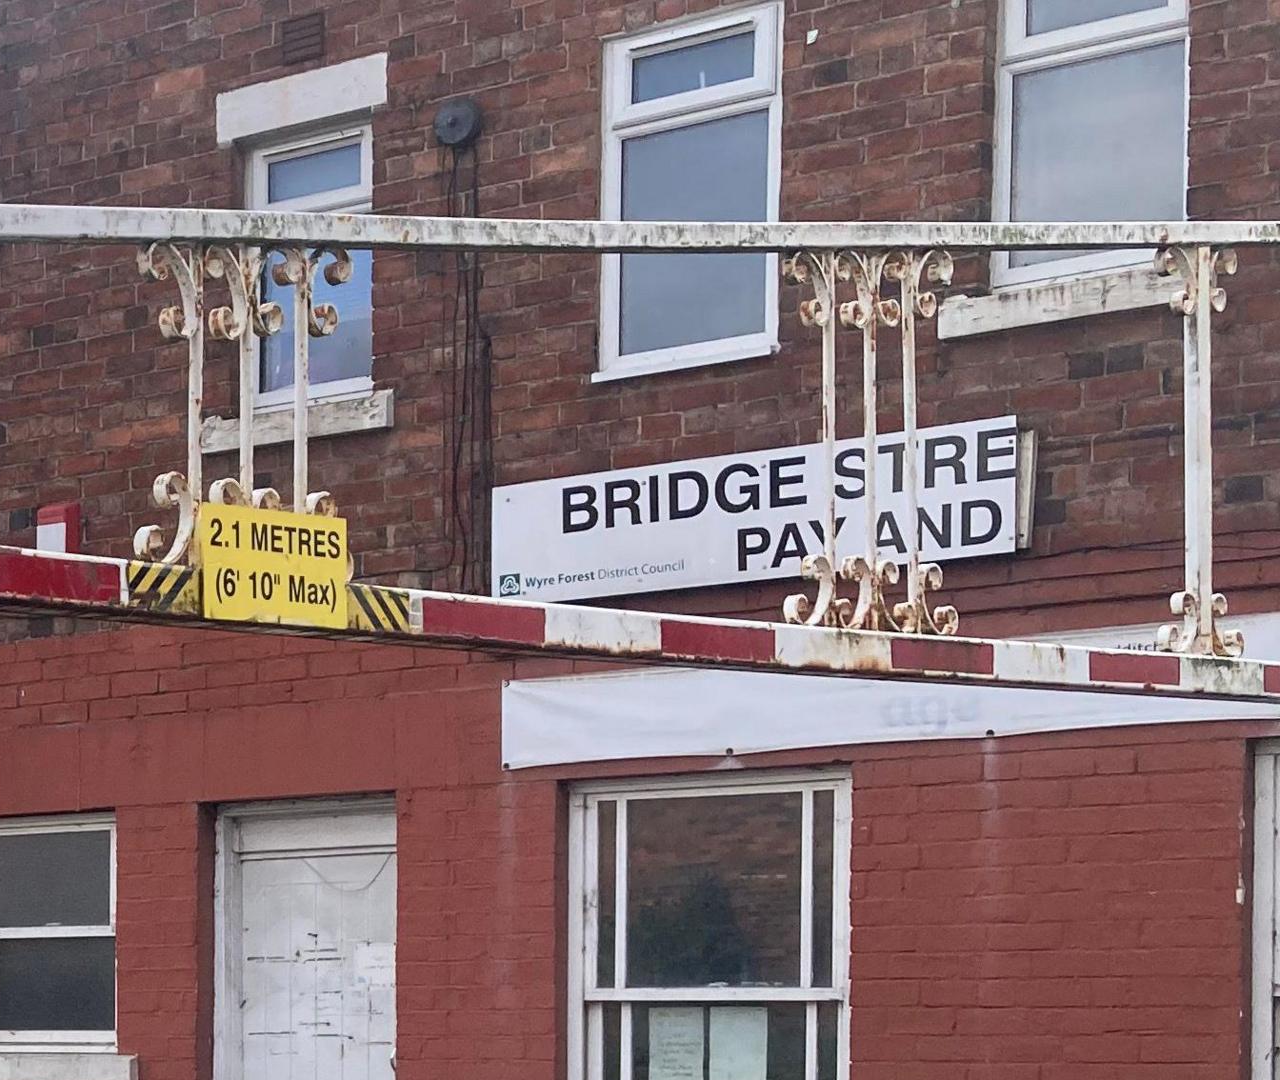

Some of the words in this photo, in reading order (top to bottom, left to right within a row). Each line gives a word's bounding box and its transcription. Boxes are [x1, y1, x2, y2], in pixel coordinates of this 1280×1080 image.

[562, 455, 808, 534] BRIDGE
[210, 518, 240, 549] 2.1
[251, 522, 341, 559] METRES
[737, 516, 847, 572] PAY
[876, 499, 1003, 554] AND
[289, 575, 337, 613] Max)
[525, 577, 555, 588] Wyre
[558, 571, 595, 584] Forest
[598, 566, 639, 580] District
[641, 559, 685, 576] Council
